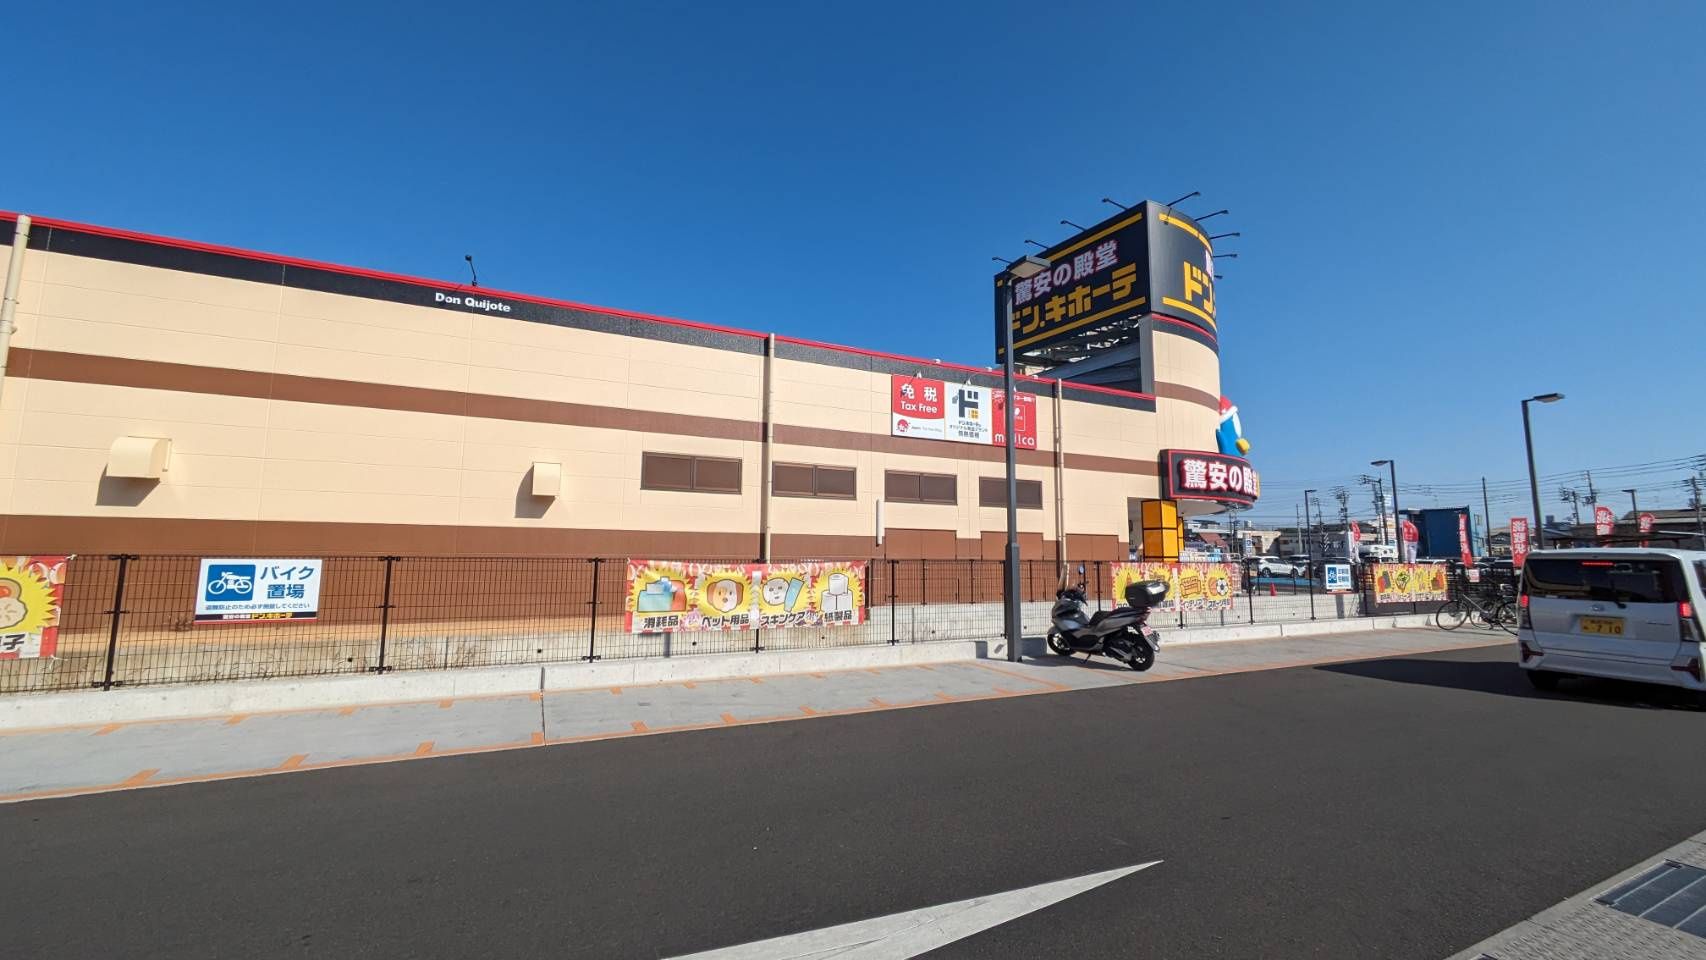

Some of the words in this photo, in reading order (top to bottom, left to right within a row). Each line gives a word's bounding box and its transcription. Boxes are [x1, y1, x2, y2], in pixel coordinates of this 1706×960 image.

[1014, 239, 1119, 305] 驚安の殿堂
[435, 292, 461, 305] Don
[464, 297, 511, 312] Quijote
[900, 383, 938, 402] 免税
[901, 400, 917, 411] Tax
[918, 403, 938, 414] Free
[260, 566, 315, 581] バイク
[267, 583, 305, 599] 置場
[643, 615, 679, 629] 消耗品
[702, 613, 750, 627] ペット用品
[760, 611, 806, 627] スキンケア
[825, 609, 853, 622] 紙製品
